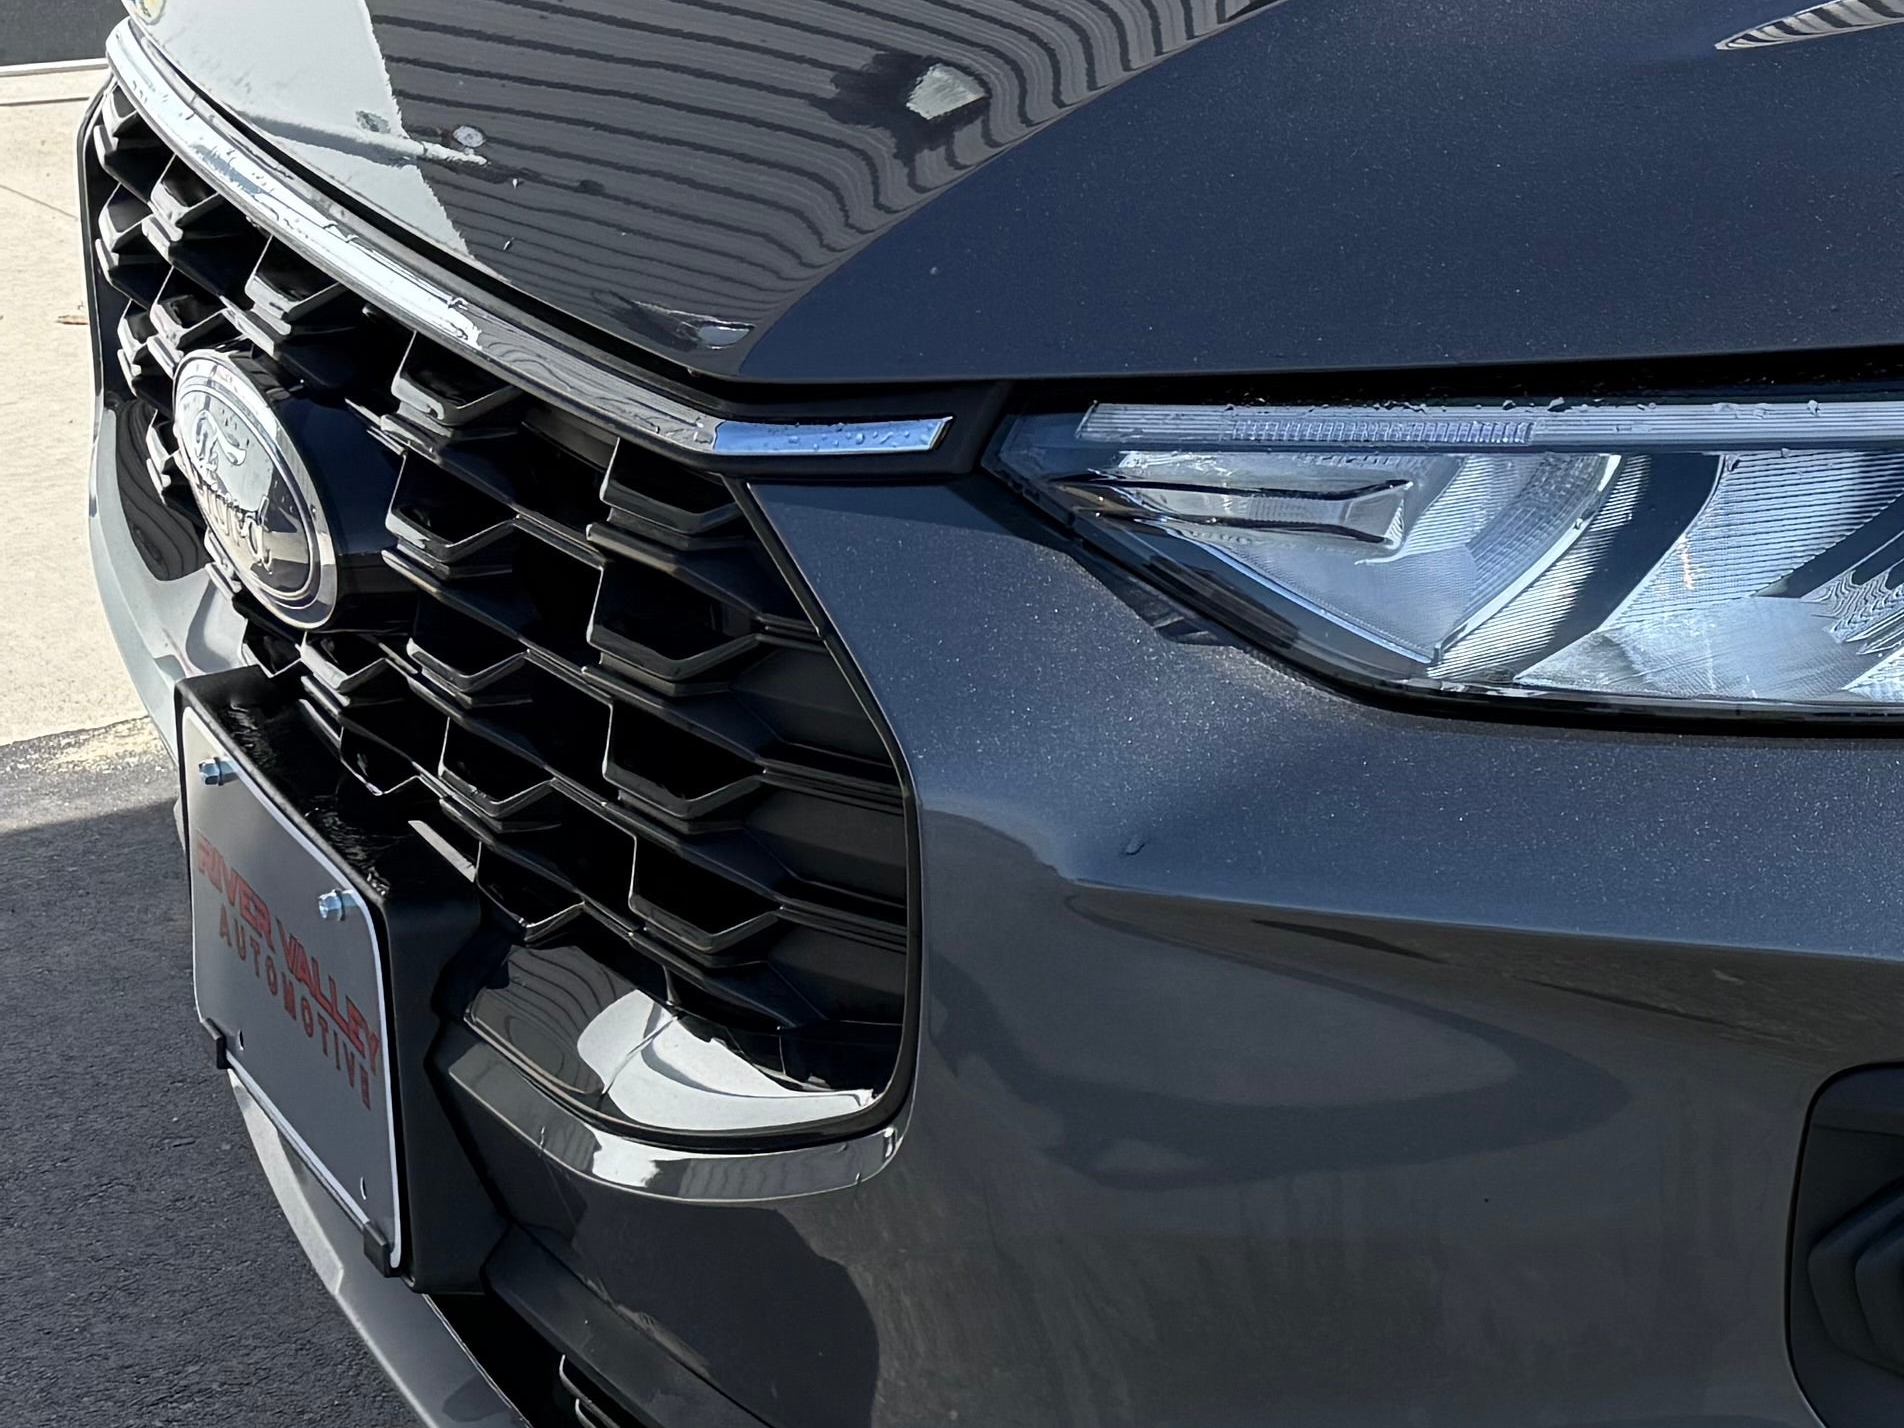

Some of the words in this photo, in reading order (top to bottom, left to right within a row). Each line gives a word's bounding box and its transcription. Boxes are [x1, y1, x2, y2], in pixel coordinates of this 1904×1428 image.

[196, 828, 276, 954] RIVER
[276, 916, 380, 1075] VALLEY
[219, 905, 371, 1111] AUTOMOTIVE
